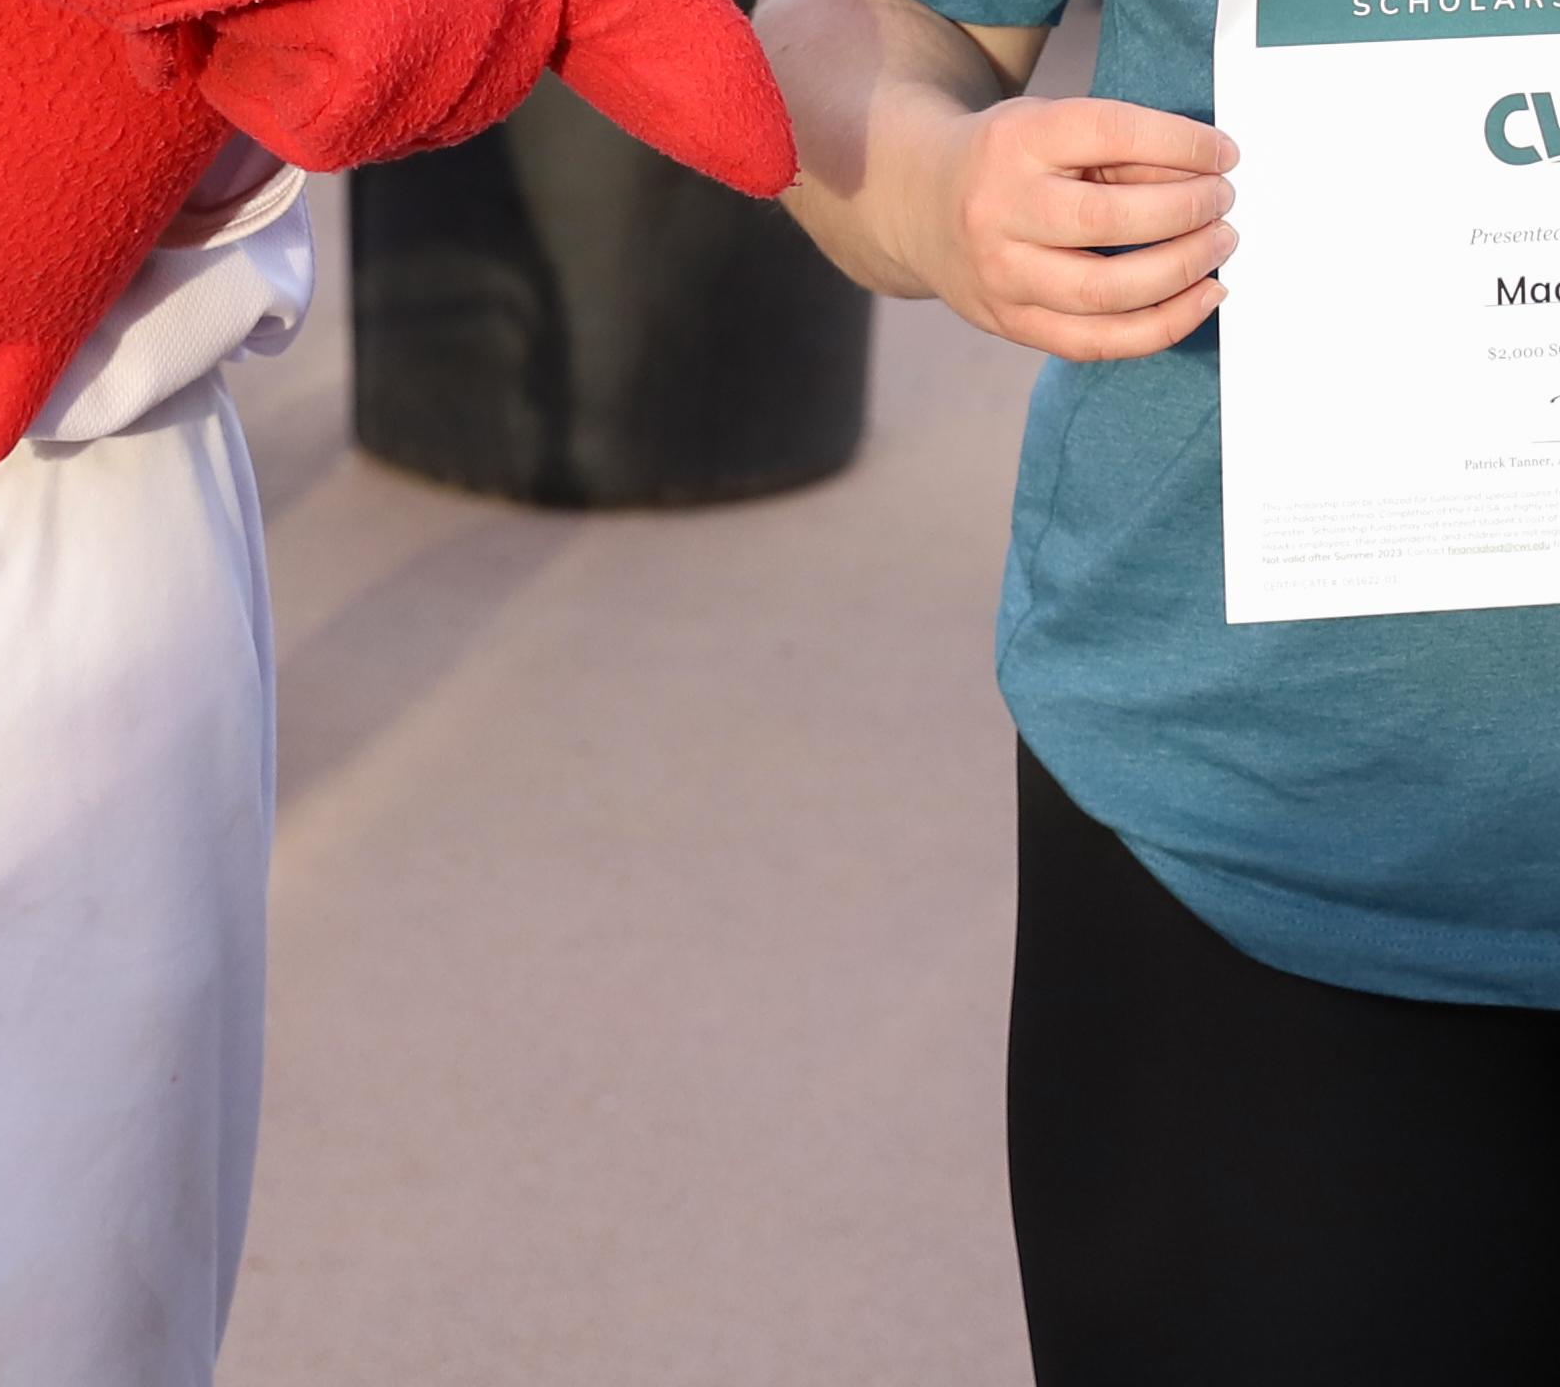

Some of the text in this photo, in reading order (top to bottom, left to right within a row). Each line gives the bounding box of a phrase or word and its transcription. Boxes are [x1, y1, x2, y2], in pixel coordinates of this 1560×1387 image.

[1488, 345, 1544, 361] $2,000
[1464, 457, 1506, 471] Patrick
[1509, 455, 1554, 468] Tanner,
[1262, 556, 1278, 564] Not
[1283, 554, 1305, 563] valid
[1308, 553, 1330, 561] after
[1334, 551, 1372, 560] Summer
[1448, 540, 1549, 556] financialaid@cwi.edu
